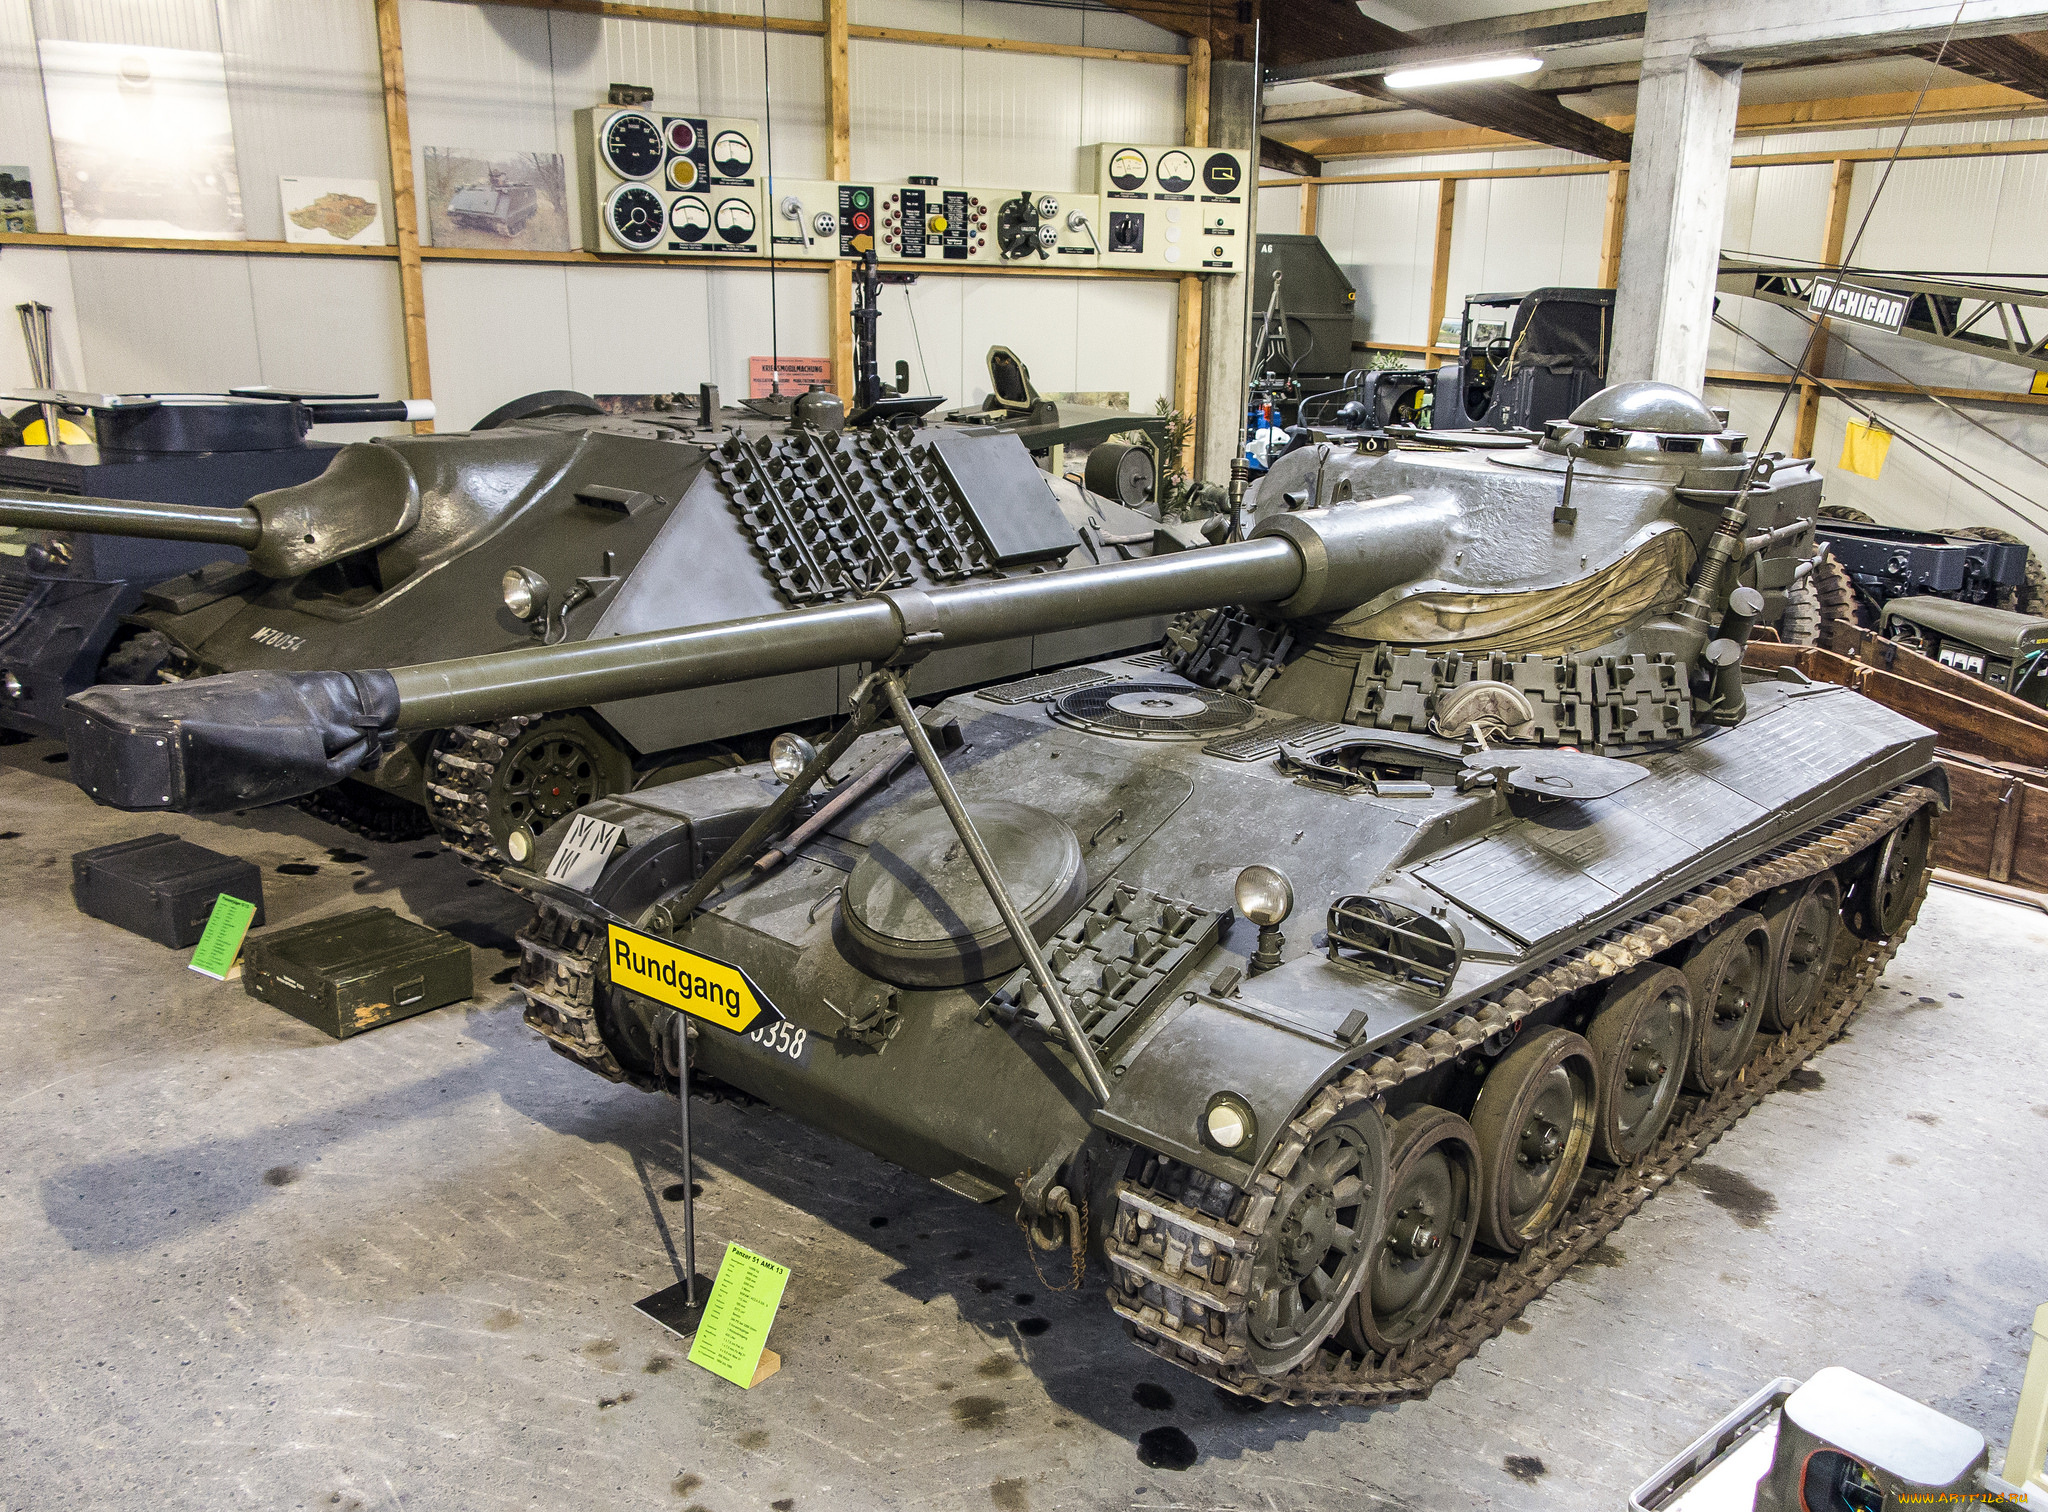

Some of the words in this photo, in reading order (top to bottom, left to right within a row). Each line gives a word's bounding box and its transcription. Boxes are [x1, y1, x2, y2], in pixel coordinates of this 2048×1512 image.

[1260, 243, 1274, 253] A6
[1811, 283, 1904, 327] MICHIGAN
[614, 938, 741, 1018] Rundgang
[731, 1247, 752, 1261] Panzer
[751, 1255, 760, 1264] 51
[760, 1260, 775, 1271] AMX
[775, 1265, 784, 1275] 13
